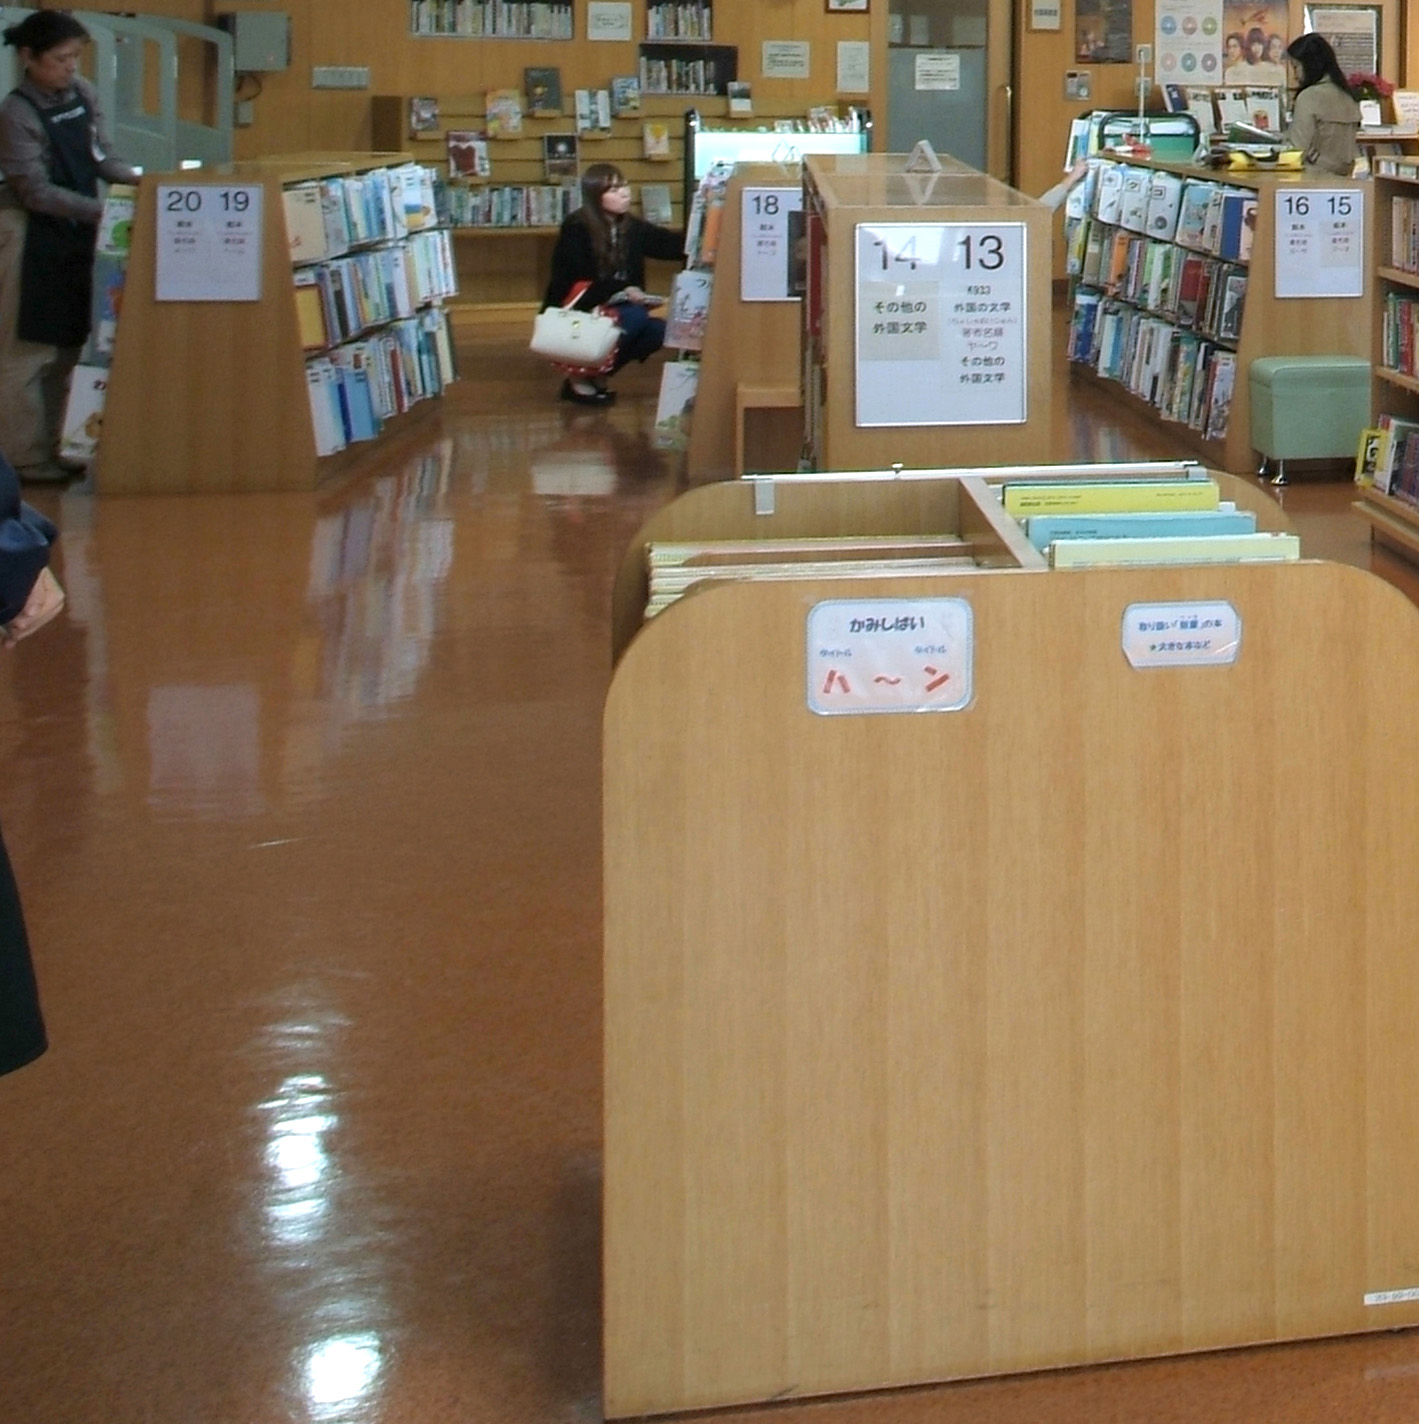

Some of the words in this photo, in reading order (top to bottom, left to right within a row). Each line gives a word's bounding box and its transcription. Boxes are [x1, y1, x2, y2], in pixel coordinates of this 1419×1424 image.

[167, 190, 202, 212] 20
[219, 190, 250, 212] 19
[752, 194, 780, 215] 18
[1283, 195, 1310, 216] 16
[1326, 195, 1352, 216] 15
[873, 234, 921, 271] 14
[957, 234, 1005, 271] 13
[873, 301, 927, 314] その他の
[953, 301, 1012, 313] 外国の文学
[873, 321, 928, 335] 外国文学
[960, 356, 1006, 367] その他の
[959, 372, 1006, 384] 外国文学
[849, 615, 926, 634] かみしばい
[822, 669, 852, 694] ハ
[923, 665, 950, 693] ン
